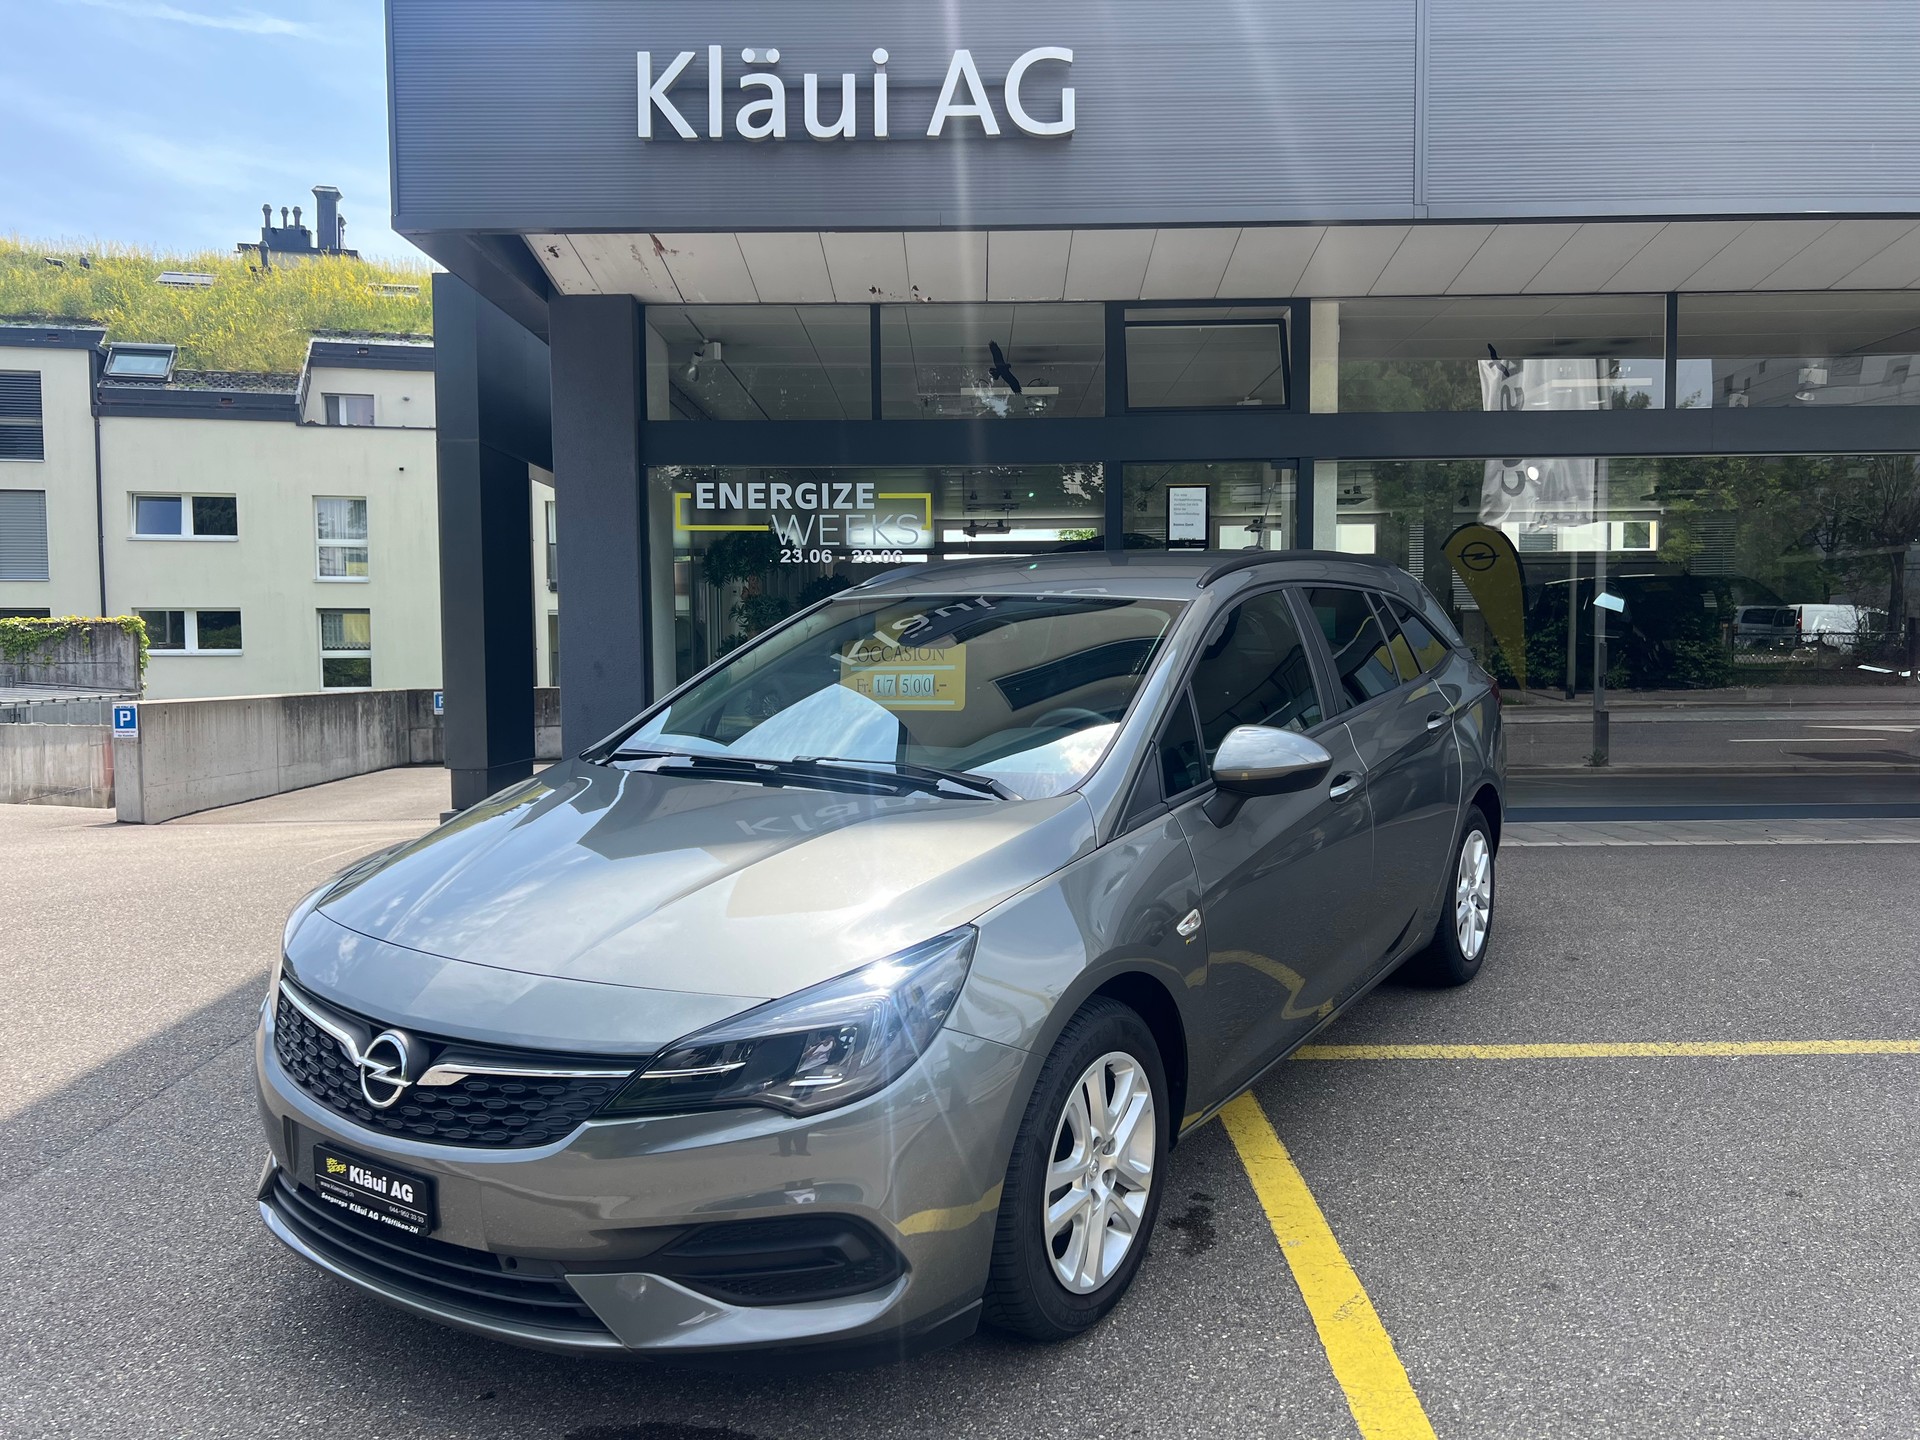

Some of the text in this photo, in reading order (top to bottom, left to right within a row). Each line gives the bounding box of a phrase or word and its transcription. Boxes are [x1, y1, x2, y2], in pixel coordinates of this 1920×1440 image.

[637, 45, 1075, 139] Kläui AG
[696, 482, 875, 510] ENERGIZE
[771, 514, 919, 546] WEEKS
[780, 549, 832, 564] 23.06
[851, 549, 903, 564] 28.06
[857, 645, 945, 662] OCCASION
[856, 678, 871, 693] Fr.
[120, 710, 130, 726] P
[350, 1165, 414, 1203] Kläui AG
[349, 1202, 368, 1216] Kläui
[368, 1210, 378, 1220] AG
